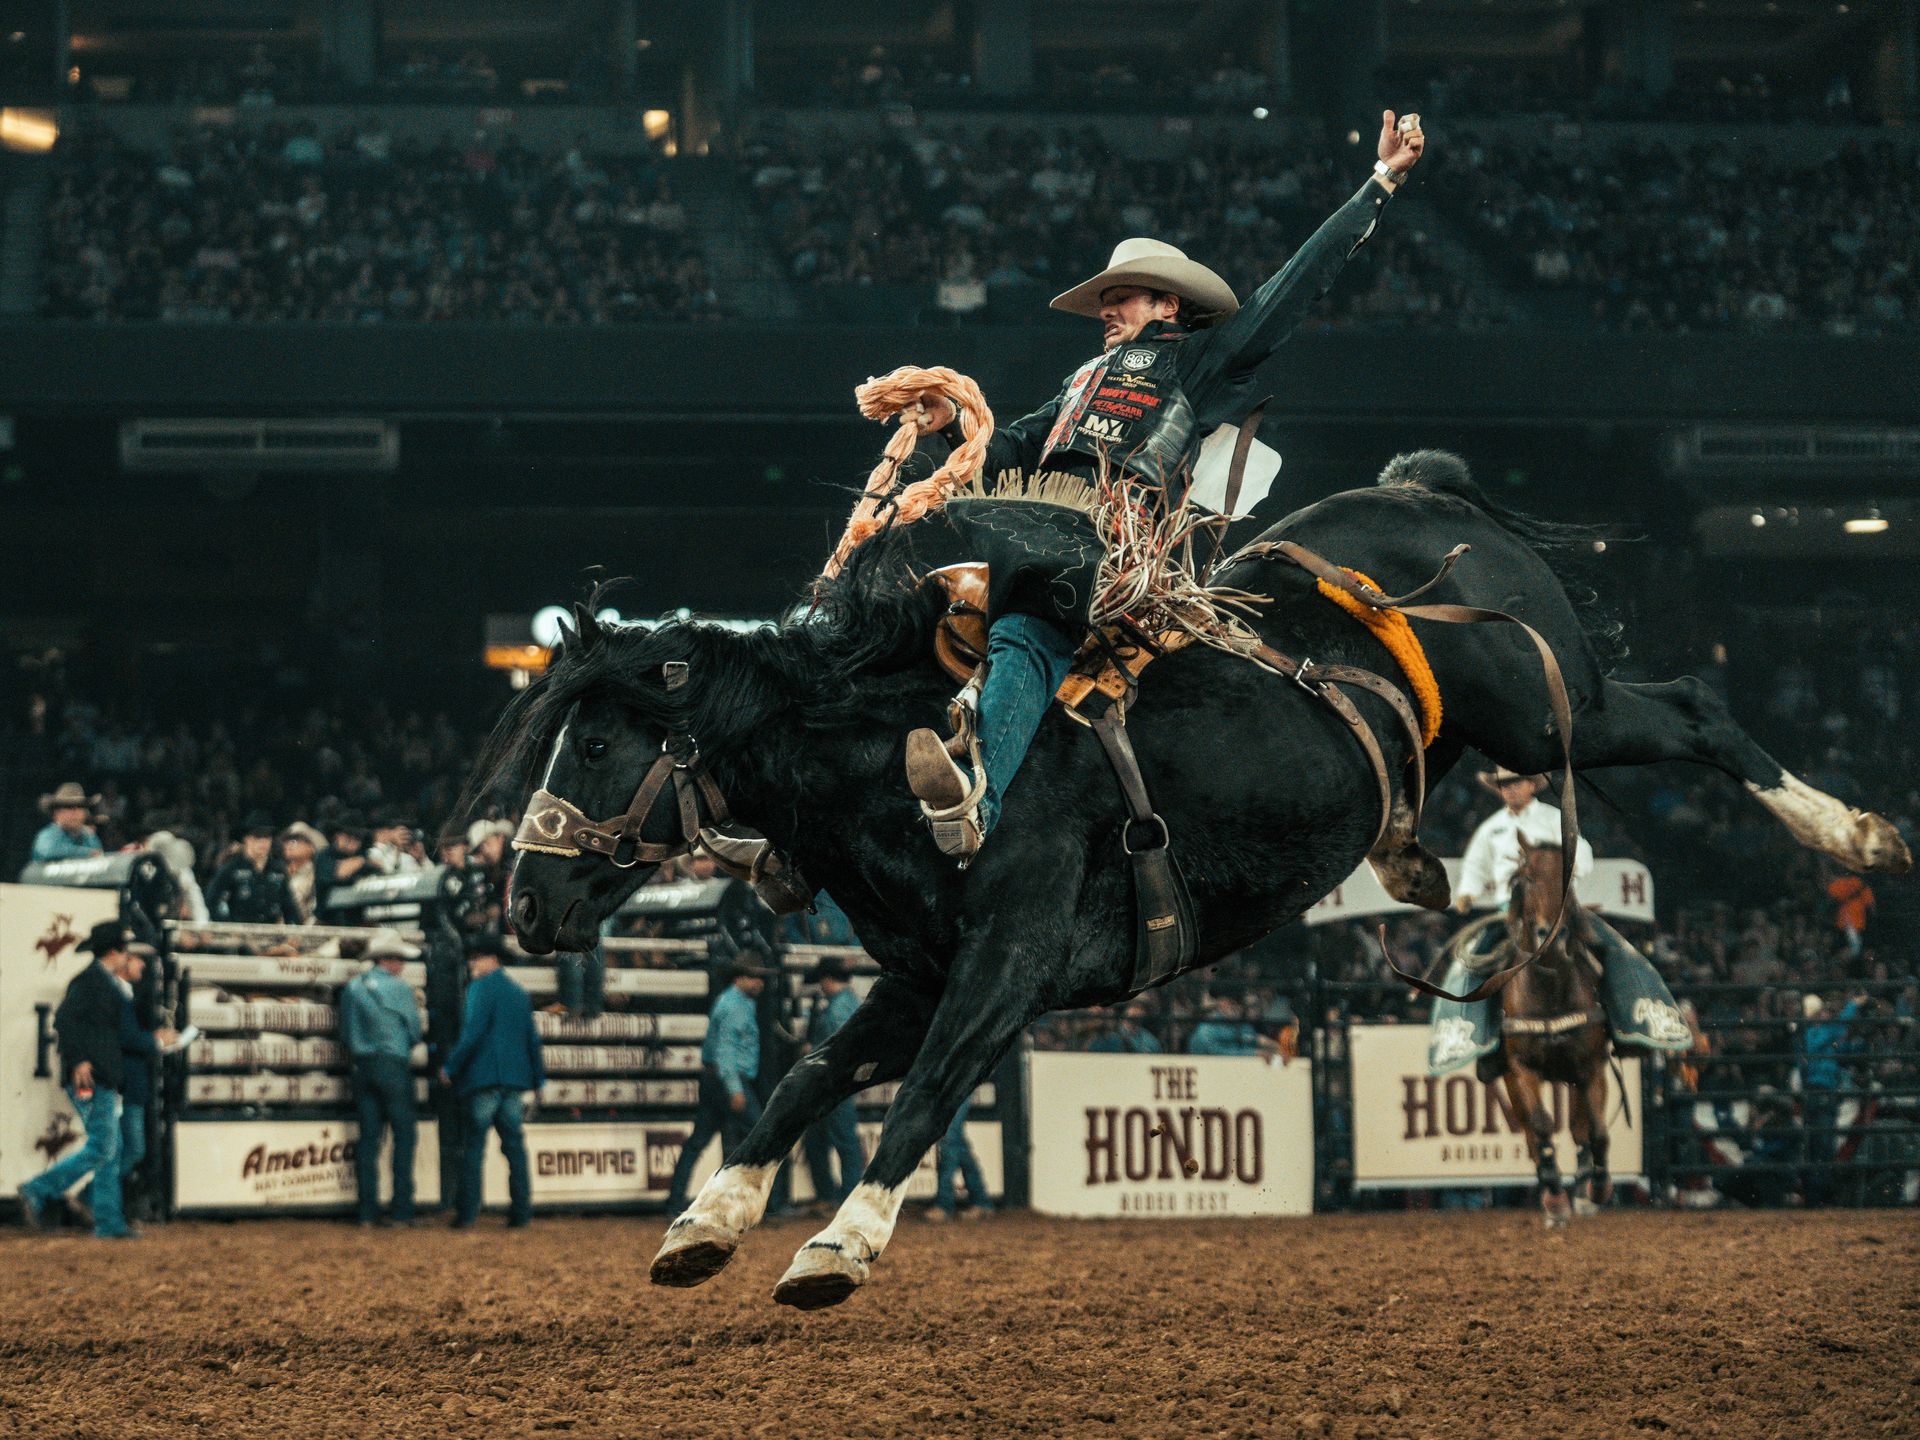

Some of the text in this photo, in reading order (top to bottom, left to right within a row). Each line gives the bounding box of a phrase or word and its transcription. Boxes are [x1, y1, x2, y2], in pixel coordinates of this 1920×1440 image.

[1125, 354, 1152, 366] 805
[1097, 387, 1129, 399] BOOT
[1127, 391, 1160, 407] BARN
[1084, 414, 1124, 437] MY
[1151, 1066, 1198, 1100] THE
[1085, 1107, 1264, 1185] HONDO
[1186, 1191, 1229, 1211] FEST
